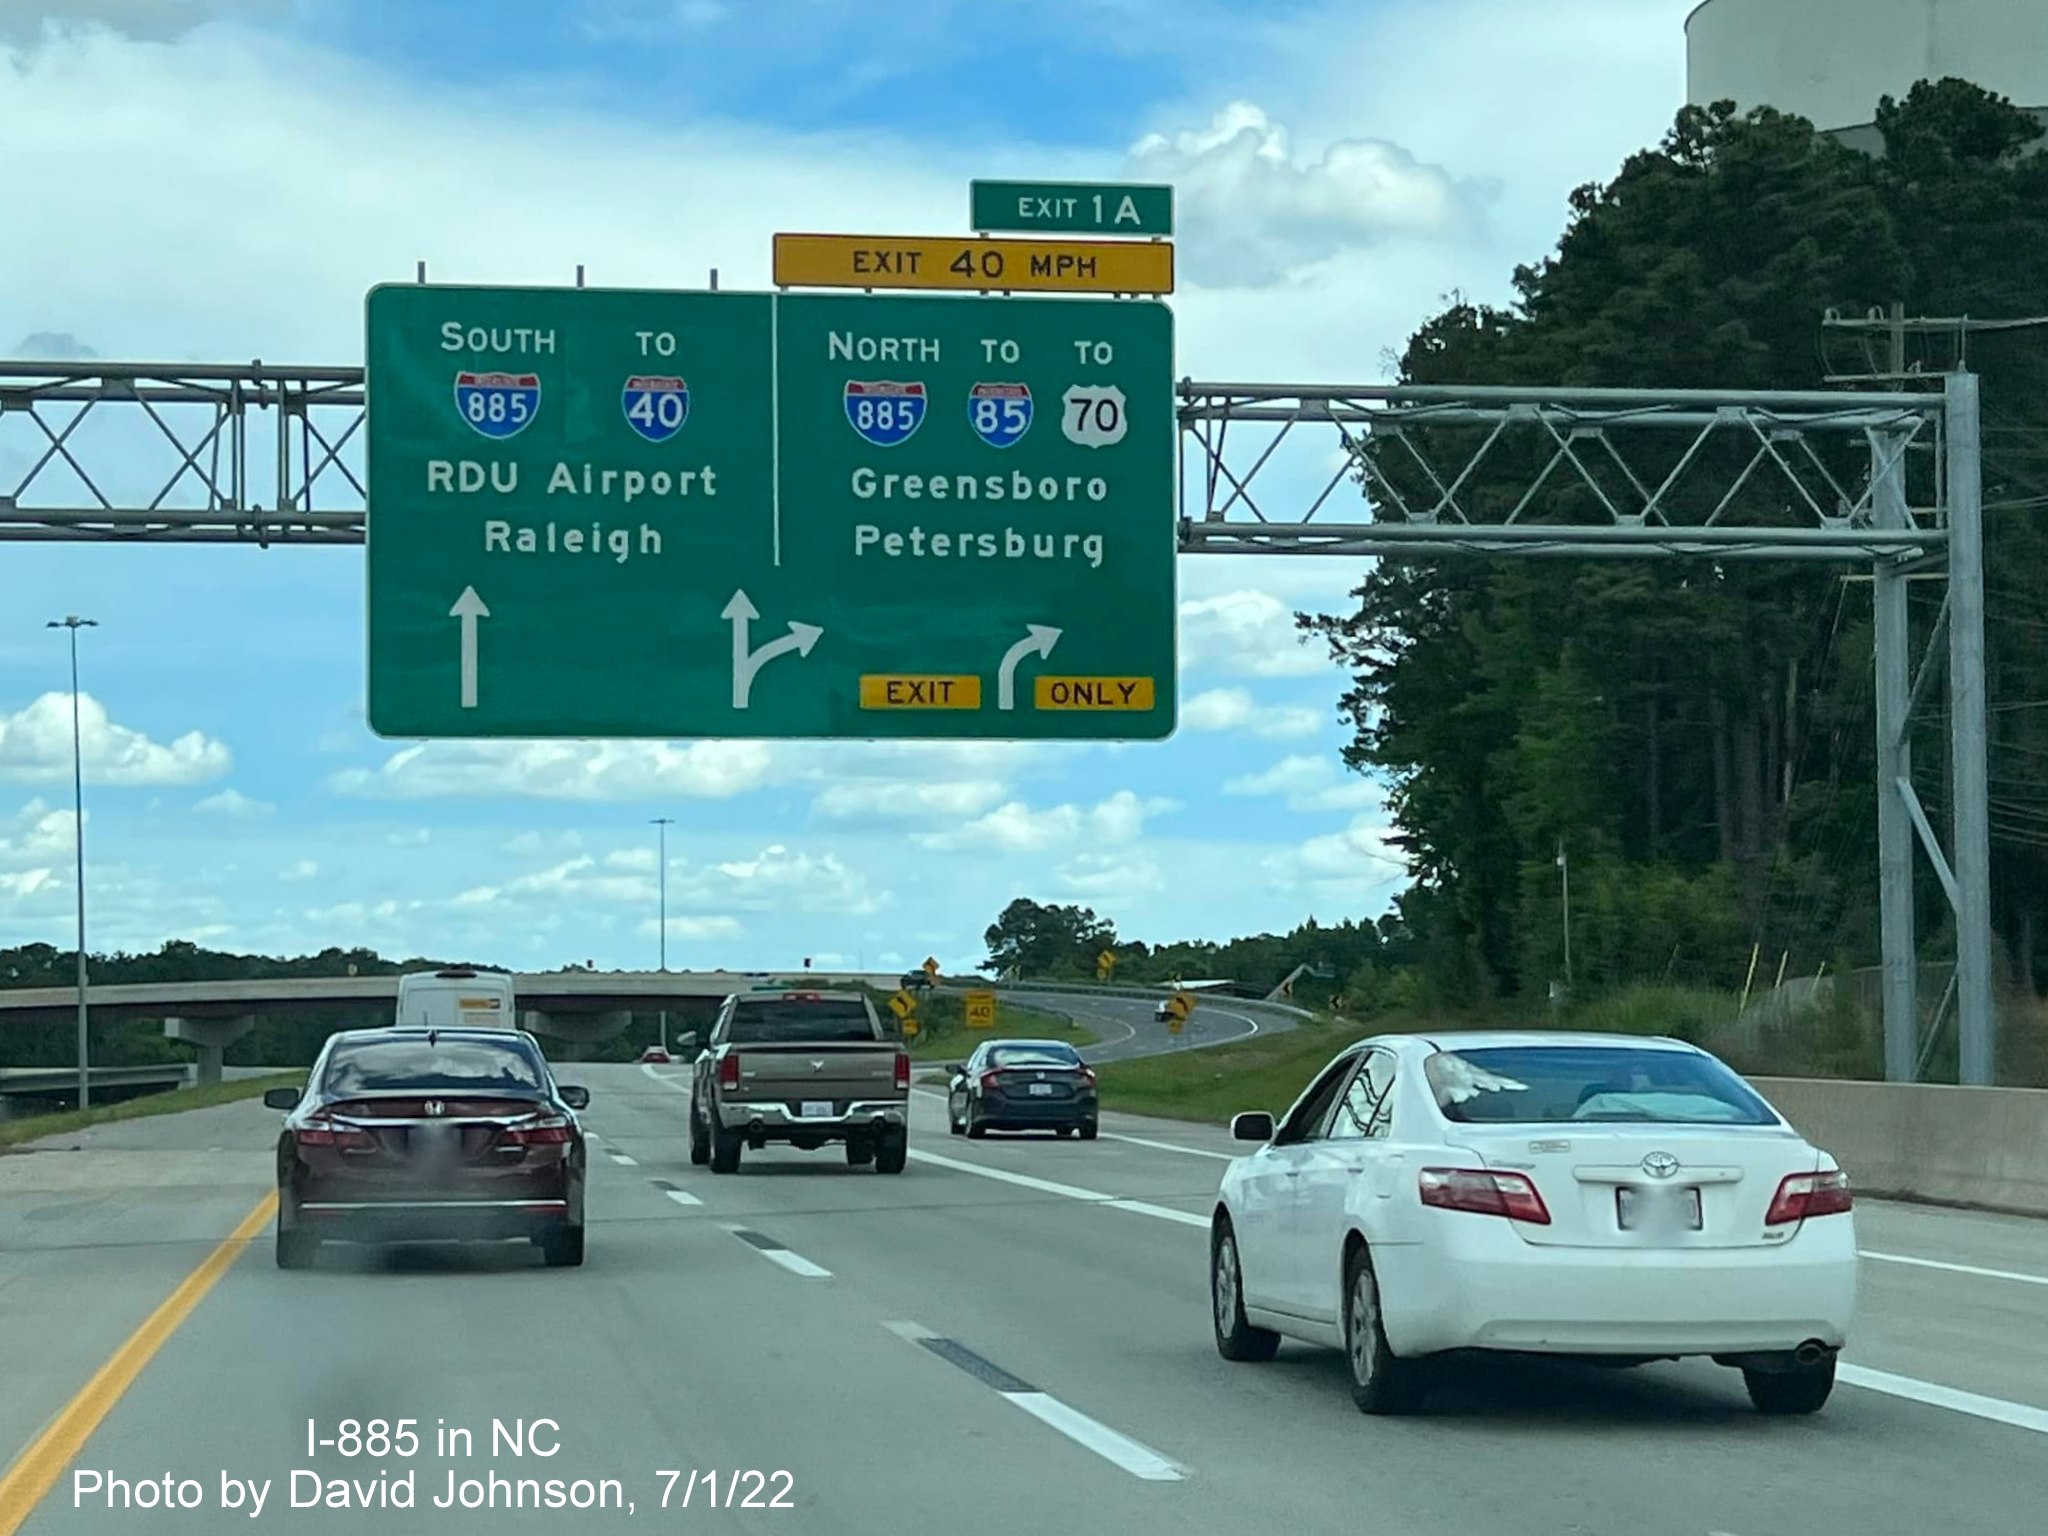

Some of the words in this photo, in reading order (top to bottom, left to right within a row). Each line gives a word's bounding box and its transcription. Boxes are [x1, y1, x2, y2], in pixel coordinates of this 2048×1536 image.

[1020, 198, 1075, 216] EXIT
[1094, 196, 1140, 224] 1A
[853, 251, 922, 274] EXIT
[950, 250, 1004, 278] 40
[1031, 254, 1096, 278] MPH
[442, 323, 553, 352] SOUTH
[637, 333, 674, 355] TO
[830, 332, 938, 361] NORTH
[981, 340, 1018, 362] TO
[1075, 342, 1111, 363] TO
[467, 392, 528, 423] 885
[629, 393, 684, 428] 40
[857, 400, 914, 431] 885
[975, 400, 1027, 434] 85
[1069, 397, 1119, 433] 70
[429, 462, 516, 491] RDU
[549, 463, 715, 500] Airport
[853, 469, 1105, 499] Greensboro
[487, 522, 660, 562] Raleigh
[856, 526, 1101, 567] Petersburg
[886, 681, 956, 704] EXIT
[1051, 682, 1137, 705] ONLY
